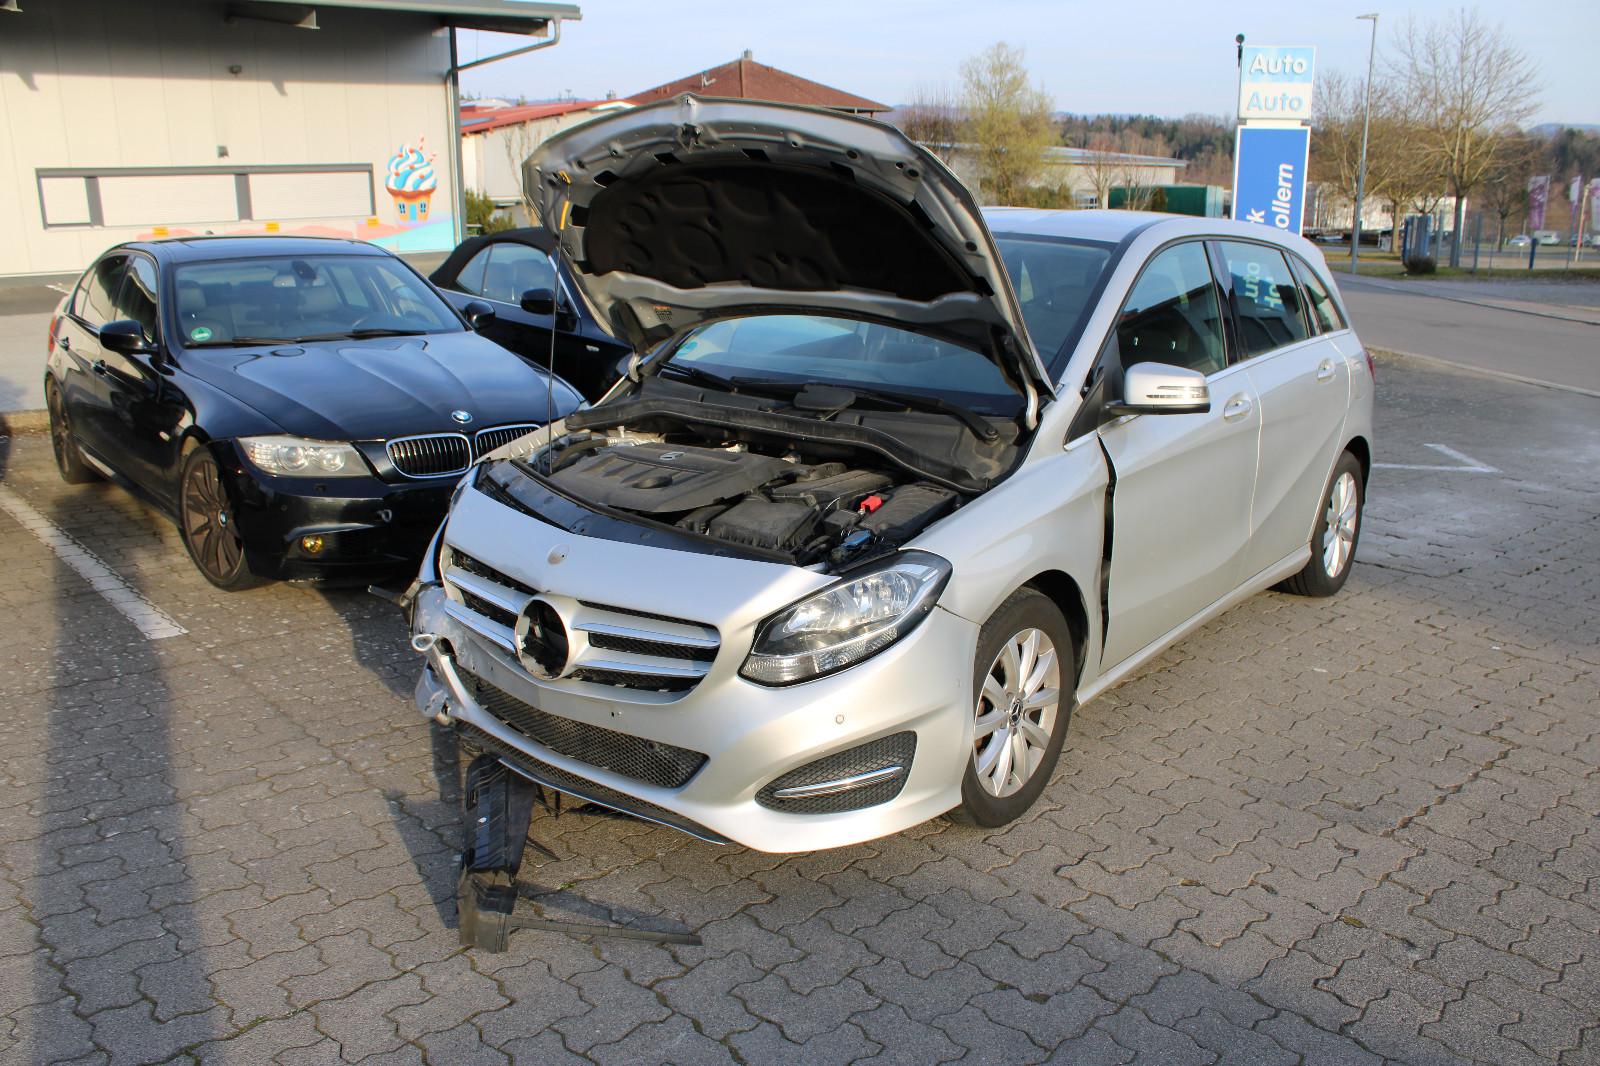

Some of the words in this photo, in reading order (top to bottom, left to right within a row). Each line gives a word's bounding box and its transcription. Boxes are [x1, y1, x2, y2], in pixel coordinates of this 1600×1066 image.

[1250, 54, 1307, 74] Auto
[1247, 91, 1303, 112] Auto
[1272, 163, 1293, 230] ollern
[1246, 208, 1266, 224] k
[1245, 262, 1260, 302] uto
